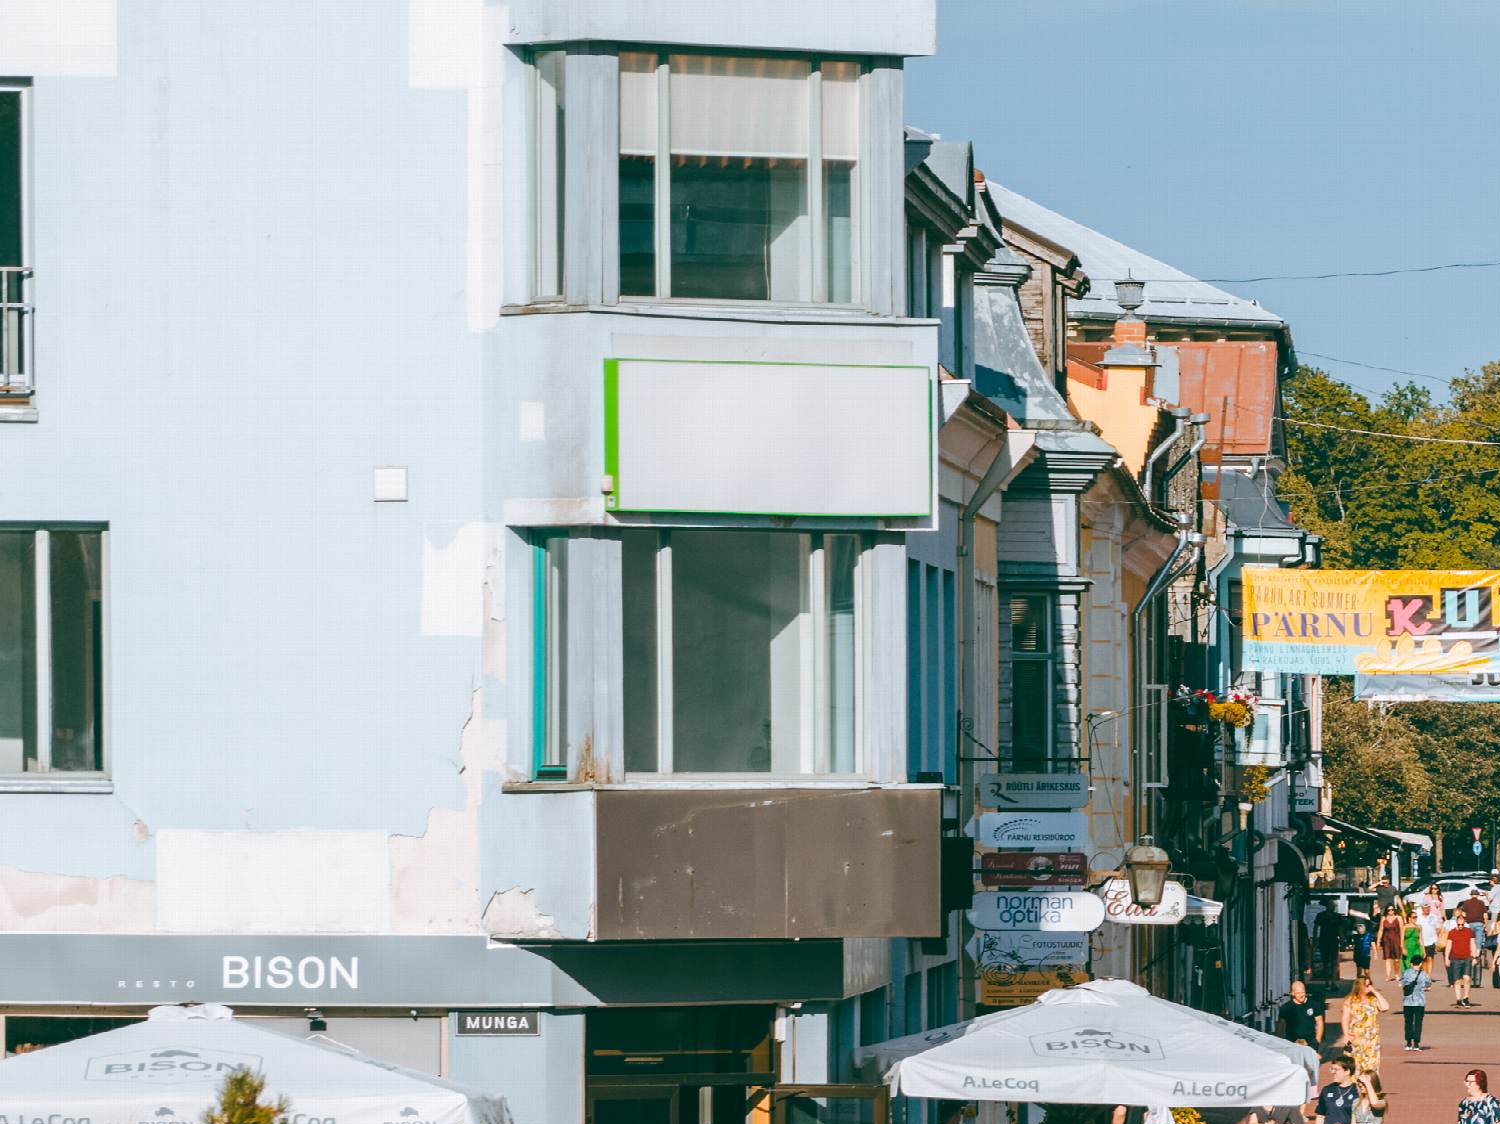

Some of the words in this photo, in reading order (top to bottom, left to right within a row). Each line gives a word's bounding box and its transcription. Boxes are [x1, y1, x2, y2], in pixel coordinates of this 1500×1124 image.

[1250, 611, 1374, 638] PÄRNU
[996, 896, 1073, 910] norman
[1000, 906, 1062, 928] optika
[223, 956, 359, 989] BISON
[118, 980, 195, 988] RESTO
[466, 1016, 529, 1030] MUNGA
[1046, 1036, 1151, 1055] BISON
[104, 1060, 248, 1075] BISON
